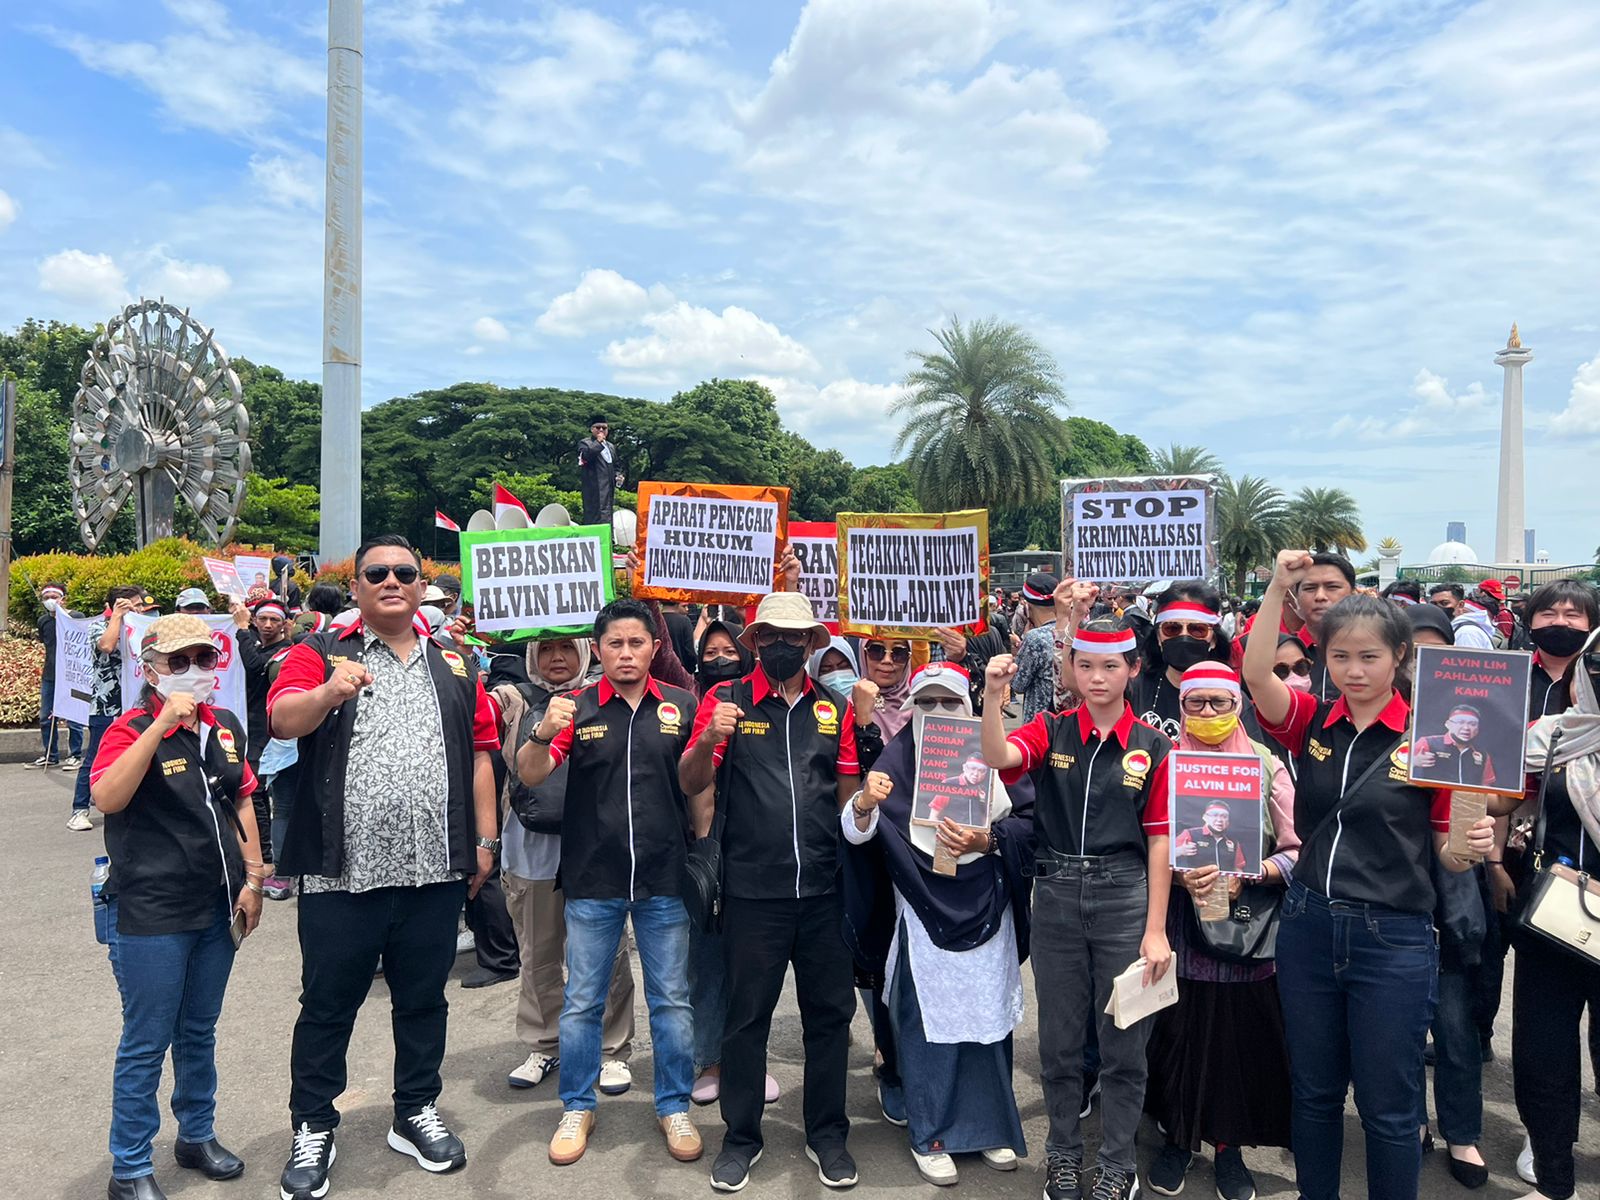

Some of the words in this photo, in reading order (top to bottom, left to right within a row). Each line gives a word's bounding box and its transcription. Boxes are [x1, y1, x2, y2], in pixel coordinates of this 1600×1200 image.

[1081, 497, 1199, 519] STOP
[652, 500, 707, 529] APARAT
[708, 504, 774, 533] PENEGAK
[663, 530, 753, 551] HUKUM
[1077, 523, 1203, 548] KRIMINALISASI
[476, 541, 597, 579] BEBASKAN
[850, 534, 921, 576] TEGAKKAN
[922, 533, 975, 576] HUKUM
[647, 547, 692, 584] JANGAN
[692, 551, 771, 586] DISKRIMINASI
[1077, 550, 1126, 577] AKTIVIS
[1128, 550, 1155, 577] DAN
[1158, 549, 1203, 577] ULAMA
[479, 584, 550, 620] ALVIN
[554, 580, 601, 614] LIM
[851, 577, 977, 623] SEADIL-ADILNYA
[1441, 657, 1481, 668] ALVIN
[1483, 660, 1508, 670] LIM
[1434, 671, 1513, 685] PAHLAWAN
[1455, 686, 1489, 697] KAMI
[924, 722, 954, 734] ALVIN
[955, 725, 974, 735] LIM
[923, 734, 965, 747] KORBAN
[921, 746, 959, 758] OKNUM
[921, 759, 948, 768] YANG
[1176, 763, 1230, 776] JUSTICE
[1232, 766, 1260, 777] FOR
[920, 770, 947, 780] HAUS
[918, 782, 978, 797] KEKUASAAN
[1183, 779, 1225, 791] ALVIN
[1227, 782, 1252, 793] LIM
